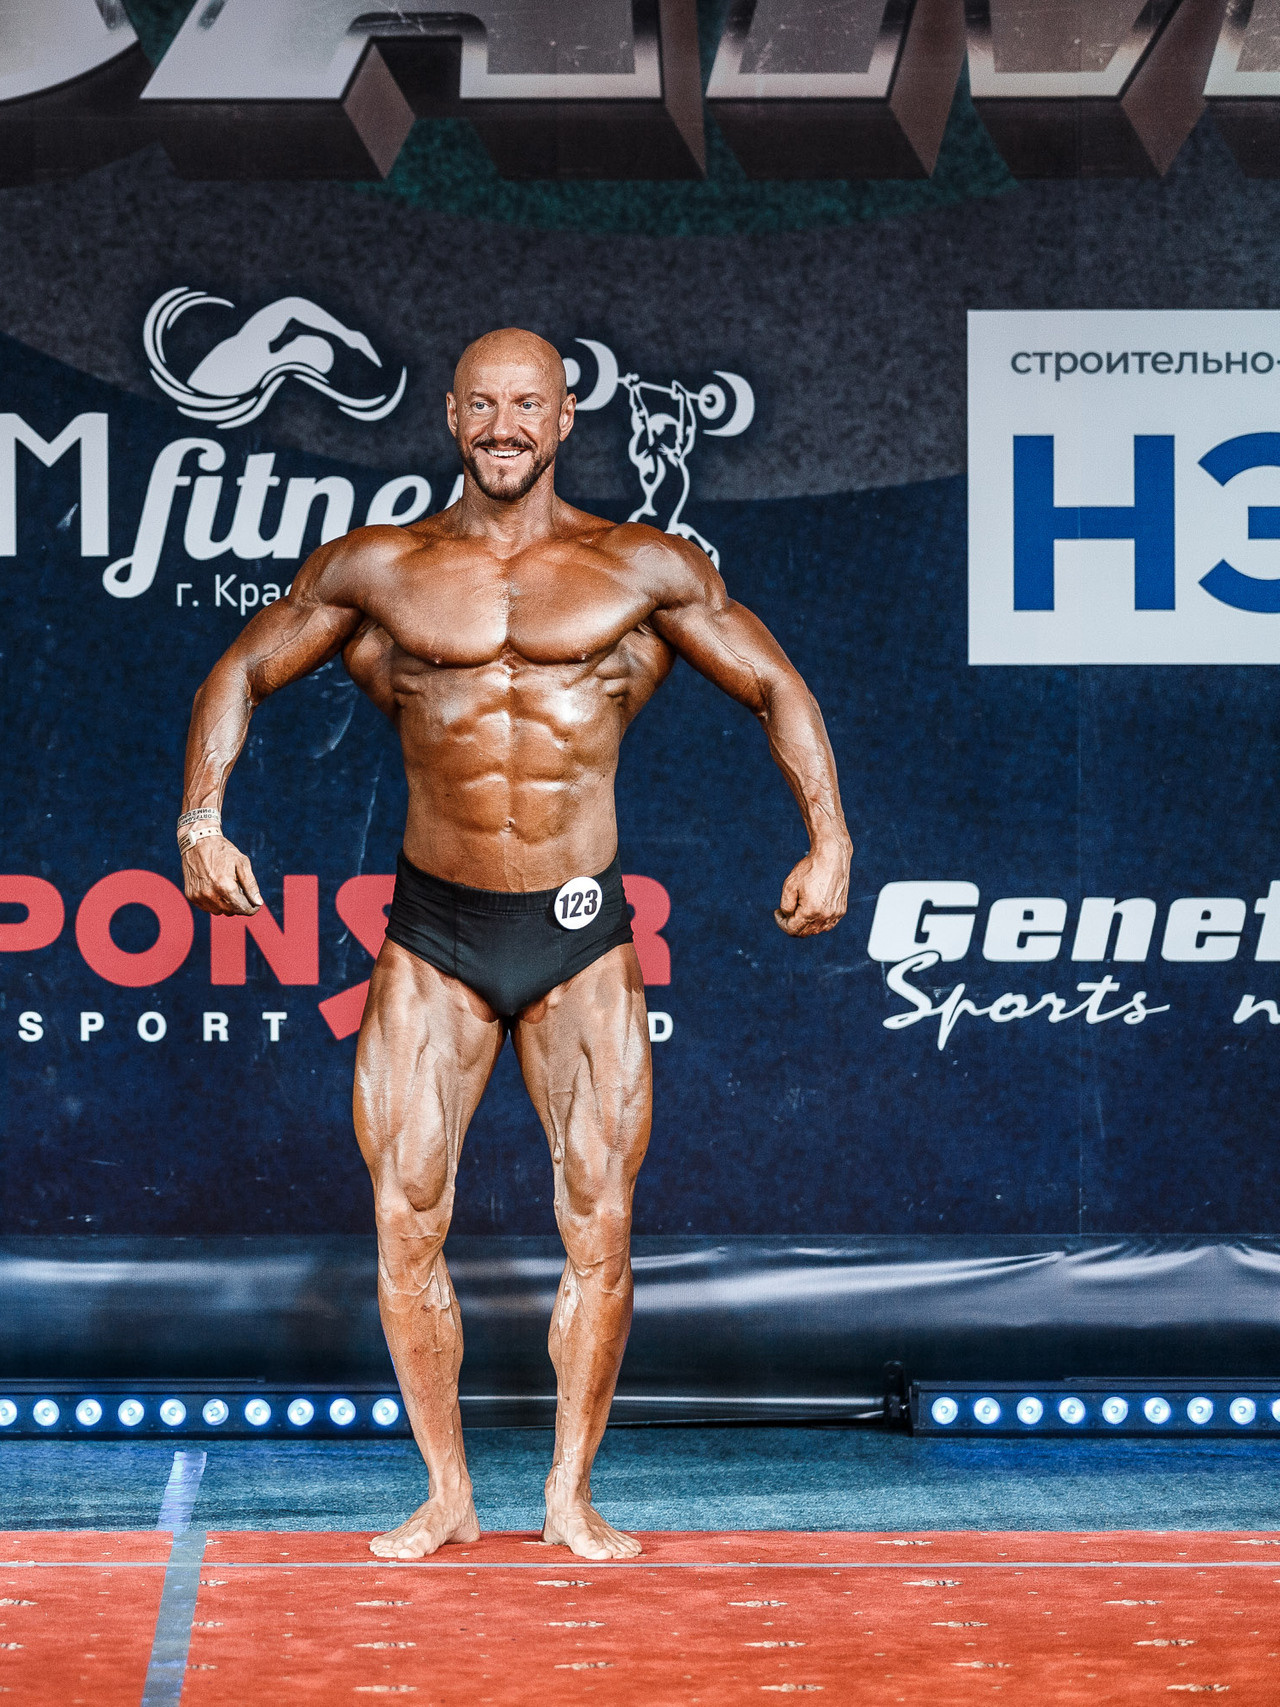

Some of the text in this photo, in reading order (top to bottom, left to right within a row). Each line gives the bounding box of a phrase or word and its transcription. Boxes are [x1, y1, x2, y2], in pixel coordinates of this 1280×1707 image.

[102, 437, 464, 598] fitne
[559, 889, 598, 919] 123
[17, 1010, 289, 1043] SPORT
[882, 950, 1171, 1051] Sports
